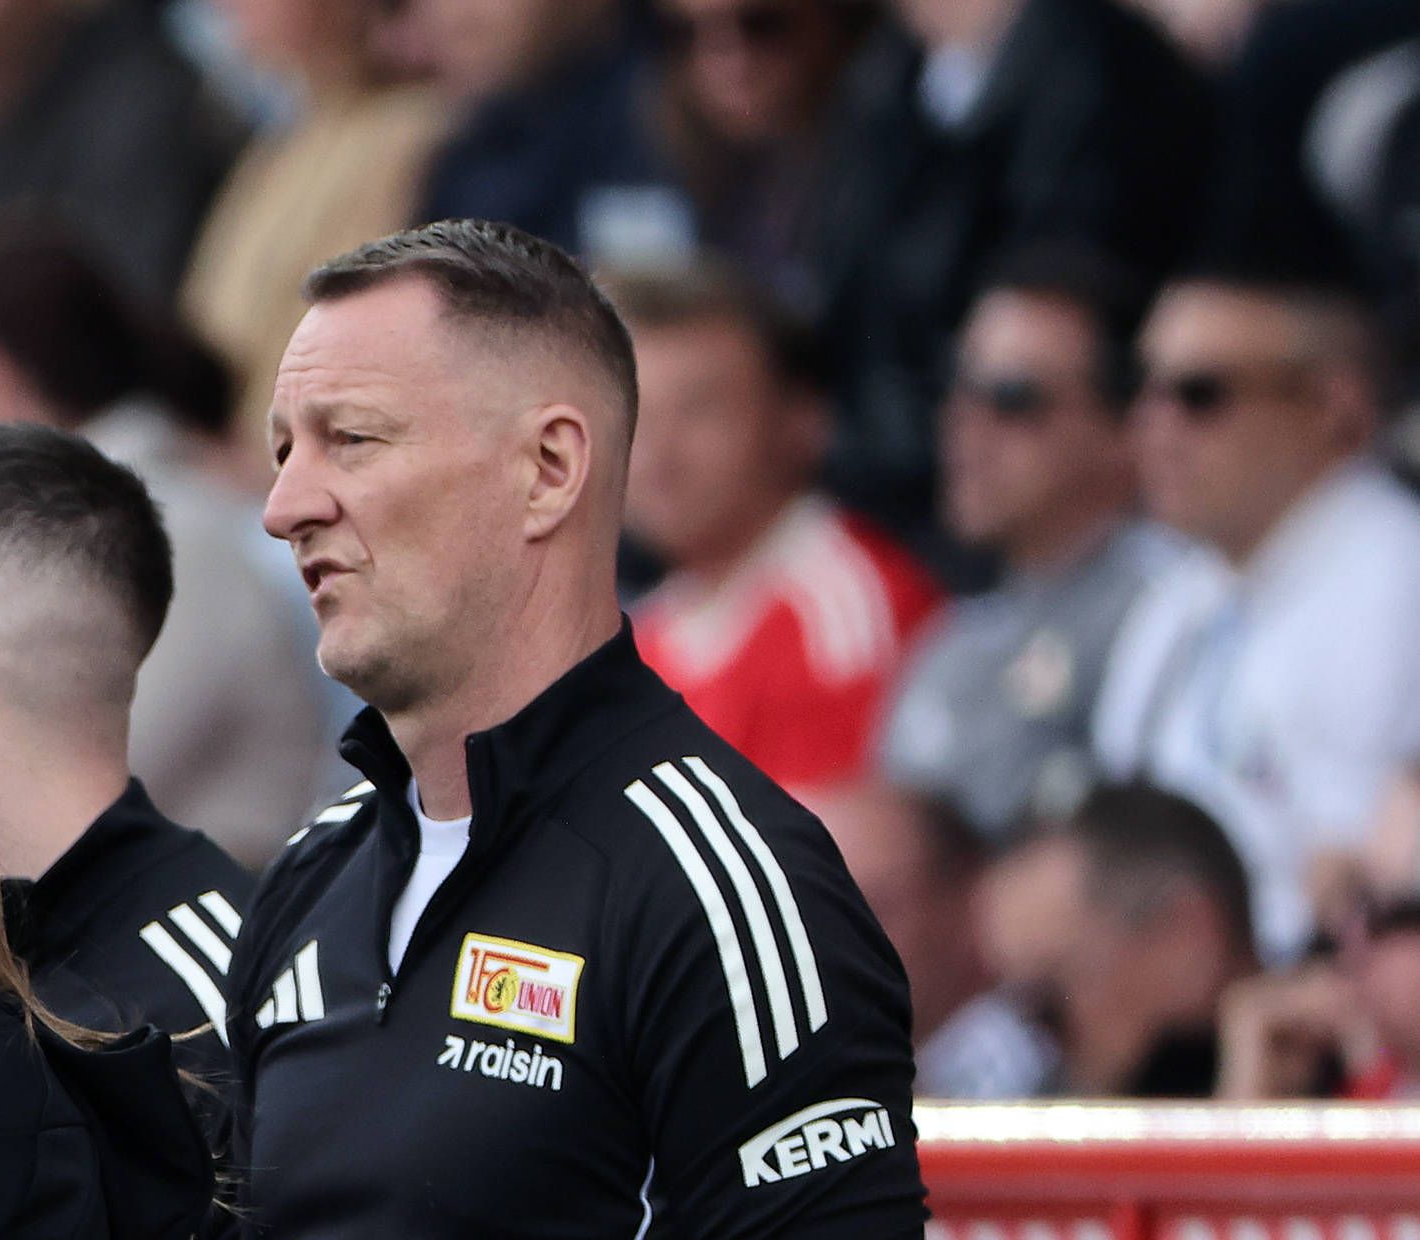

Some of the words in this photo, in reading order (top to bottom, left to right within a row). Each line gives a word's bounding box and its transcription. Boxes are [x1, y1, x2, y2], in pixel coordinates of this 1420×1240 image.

[516, 980, 565, 1019] UNION
[463, 1037, 564, 1091] raisin
[738, 1097, 897, 1188] KERMI
